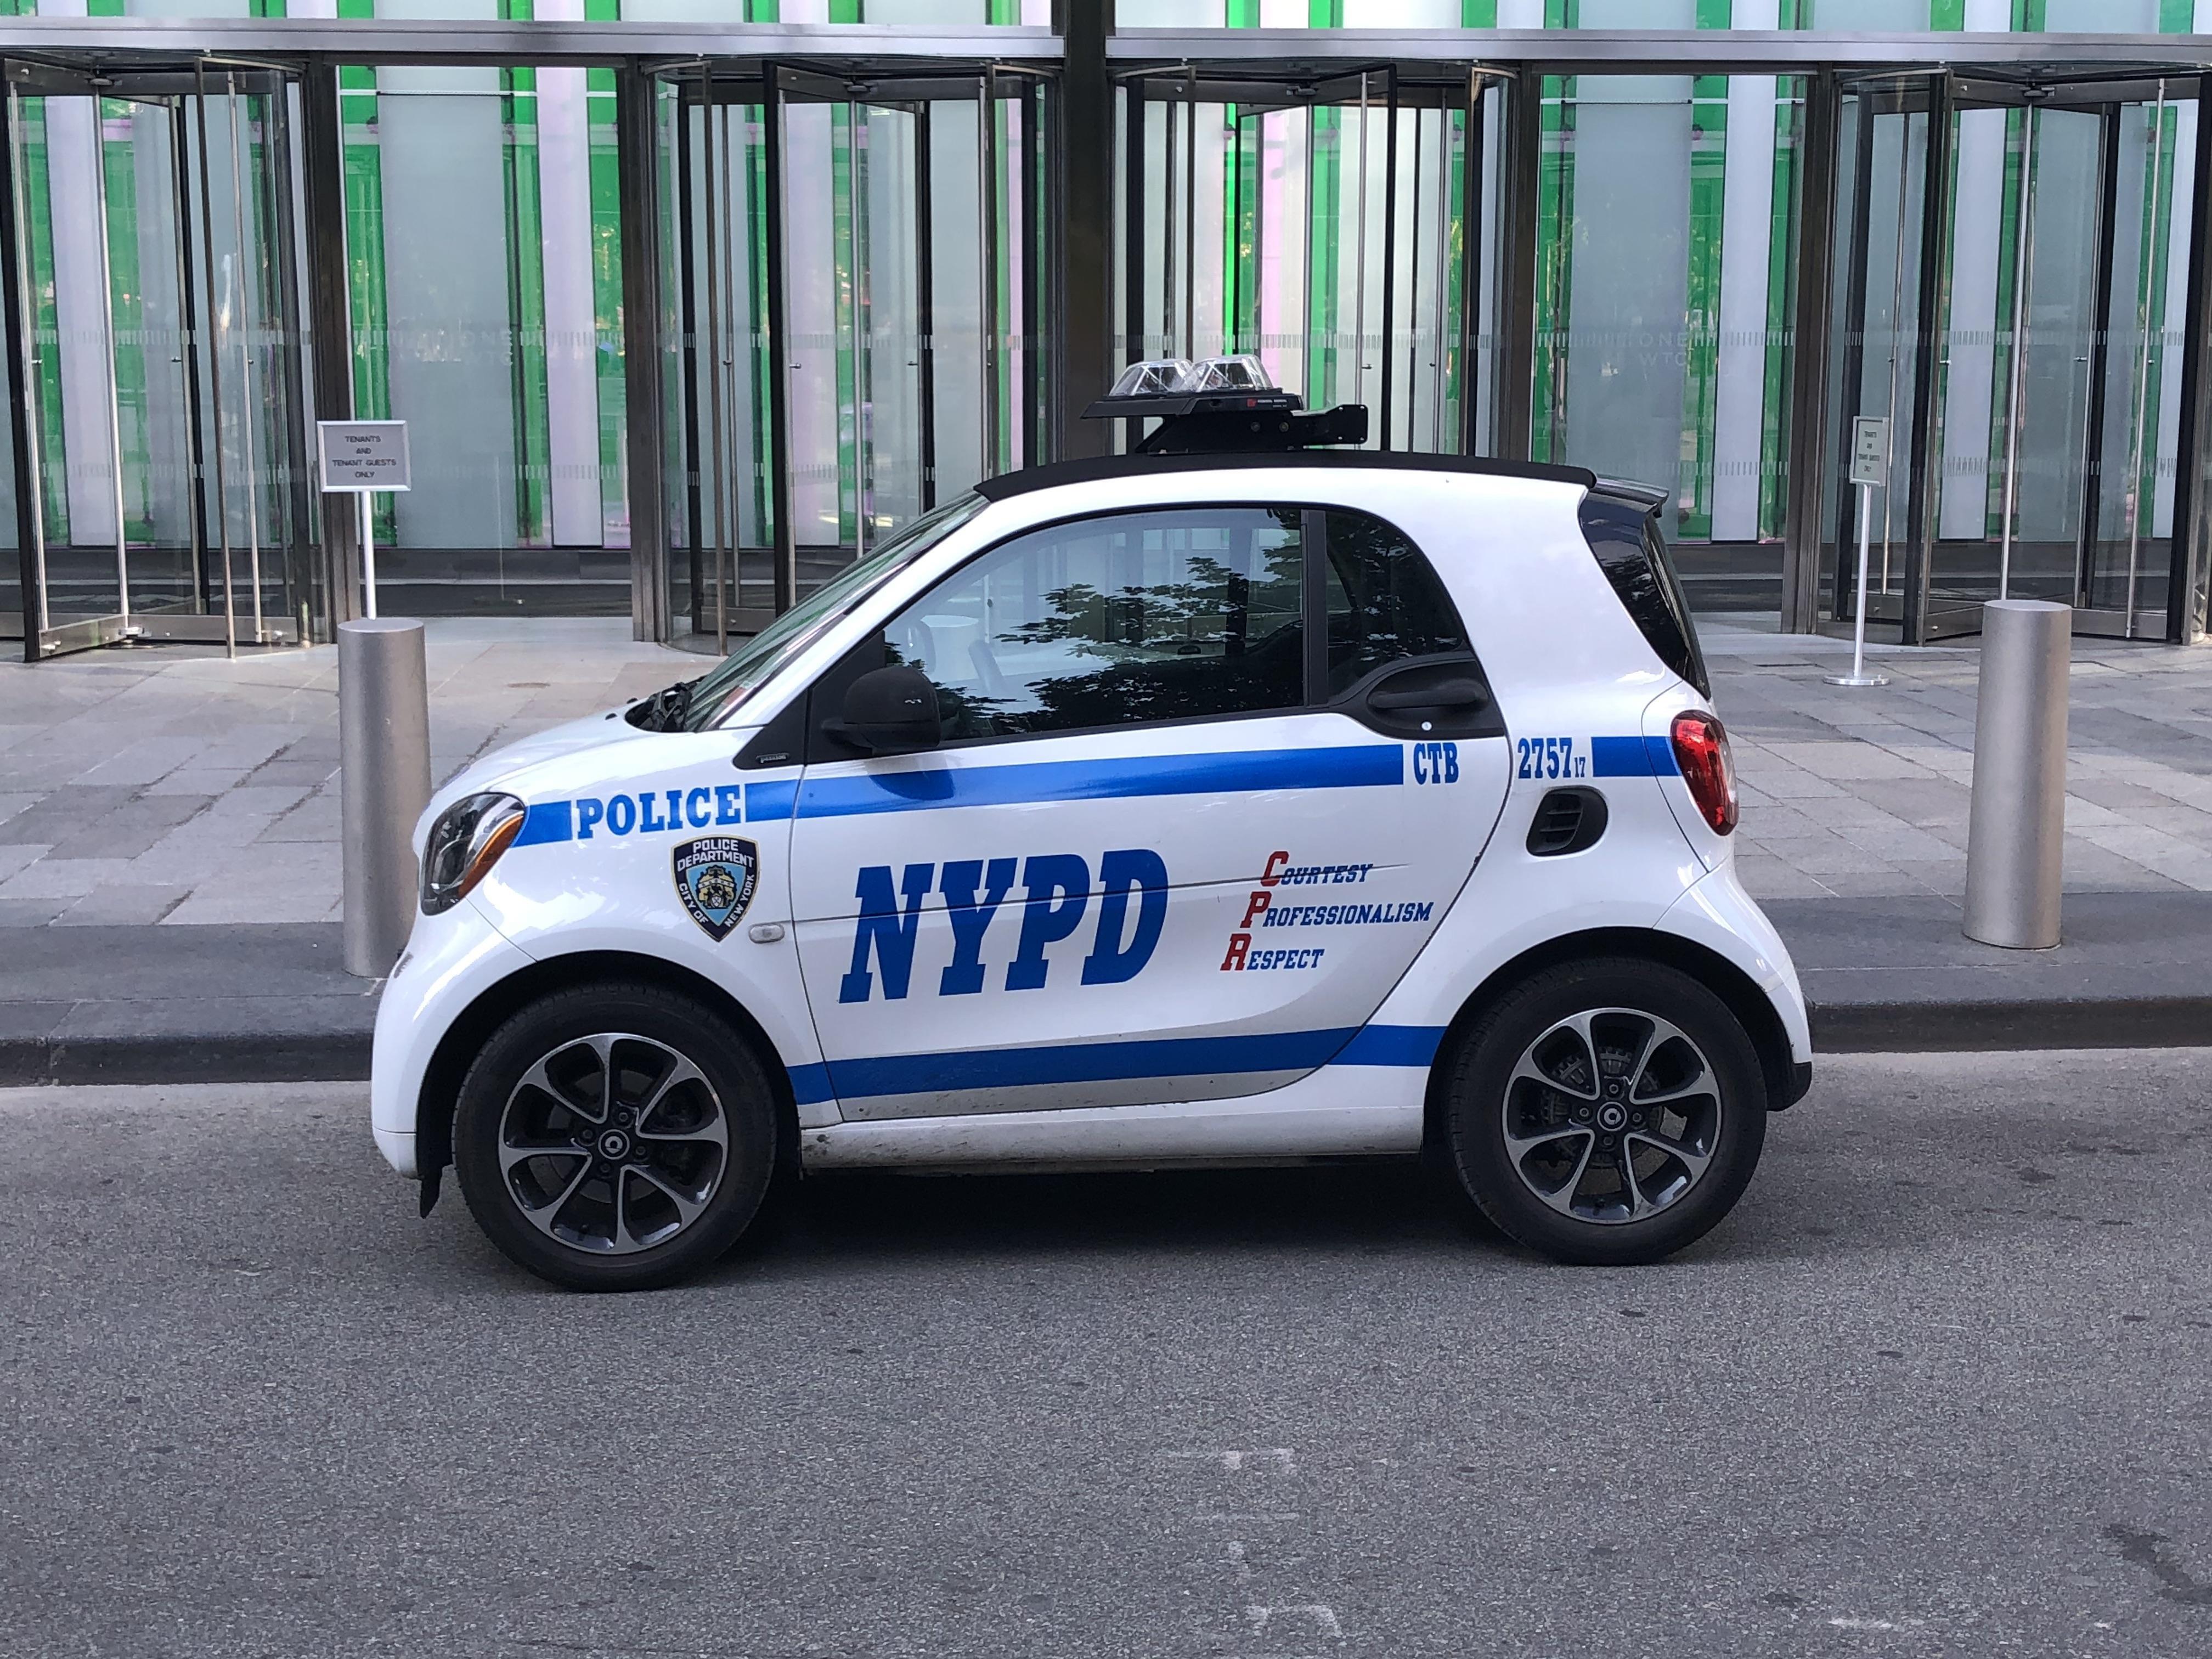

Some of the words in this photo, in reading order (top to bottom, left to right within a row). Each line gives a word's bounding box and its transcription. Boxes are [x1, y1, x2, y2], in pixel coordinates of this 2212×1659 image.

[1413, 742, 1459, 785] CTB
[1517, 737, 1572, 779] 2757
[577, 785, 741, 839] POLICE
[677, 850, 754, 872] DEPARTMENT
[693, 839, 738, 853] POLICE
[1260, 851, 1373, 887] COURTESY
[679, 883, 696, 909] CITY
[693, 910, 709, 923] OF
[724, 904, 744, 927] NEW
[740, 874, 754, 901] YORK
[1240, 891, 1434, 928] PROFESSIONALISM
[838, 849, 1169, 1003] NYPD
[1220, 933, 1325, 971] RESPECT
